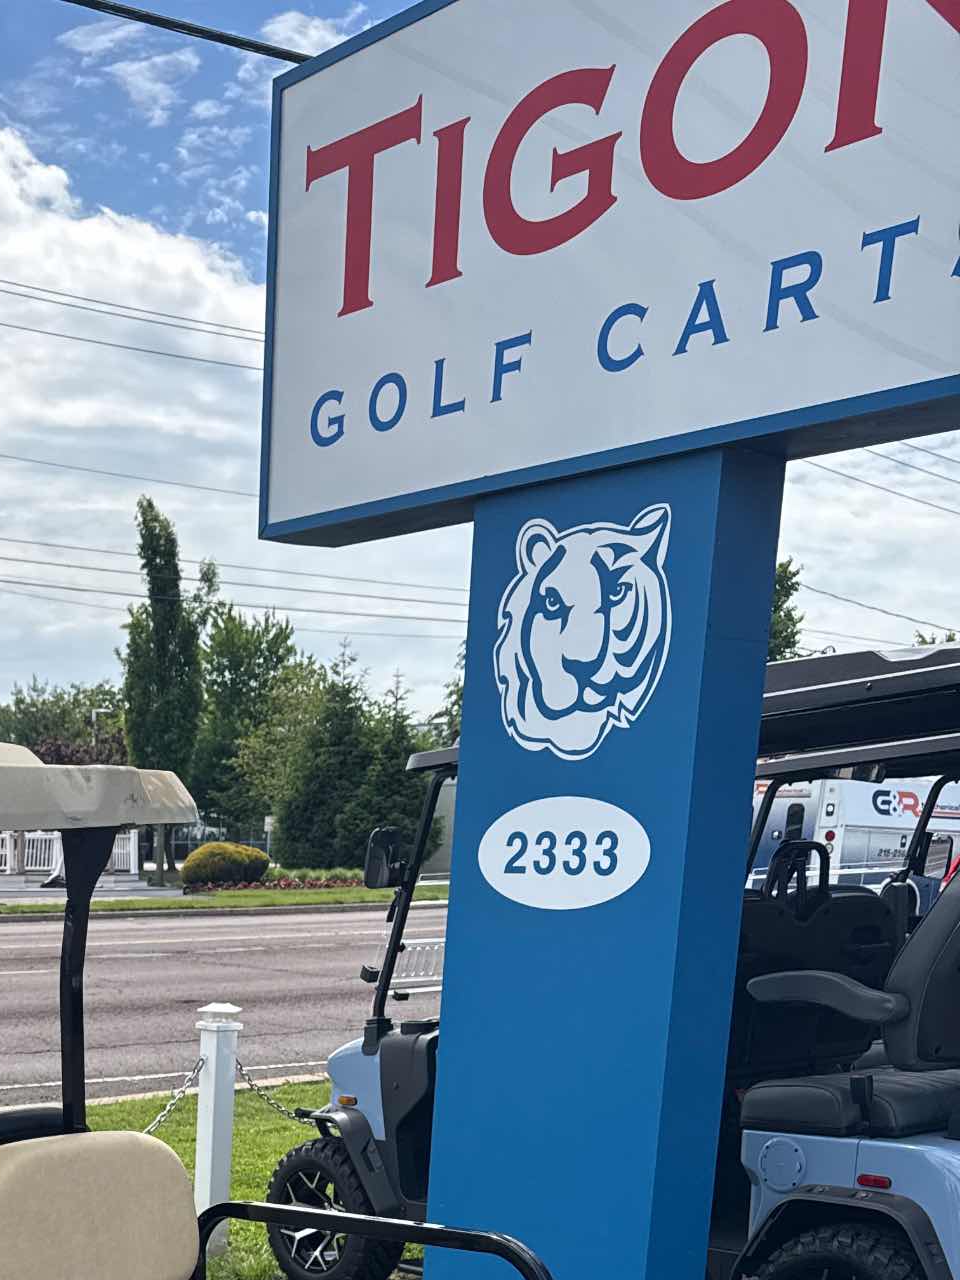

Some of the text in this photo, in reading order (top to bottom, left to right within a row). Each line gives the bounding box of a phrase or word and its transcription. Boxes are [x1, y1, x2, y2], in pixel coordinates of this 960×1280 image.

[309, 215, 960, 448] GOLF CART
[503, 830, 619, 877] 2333
